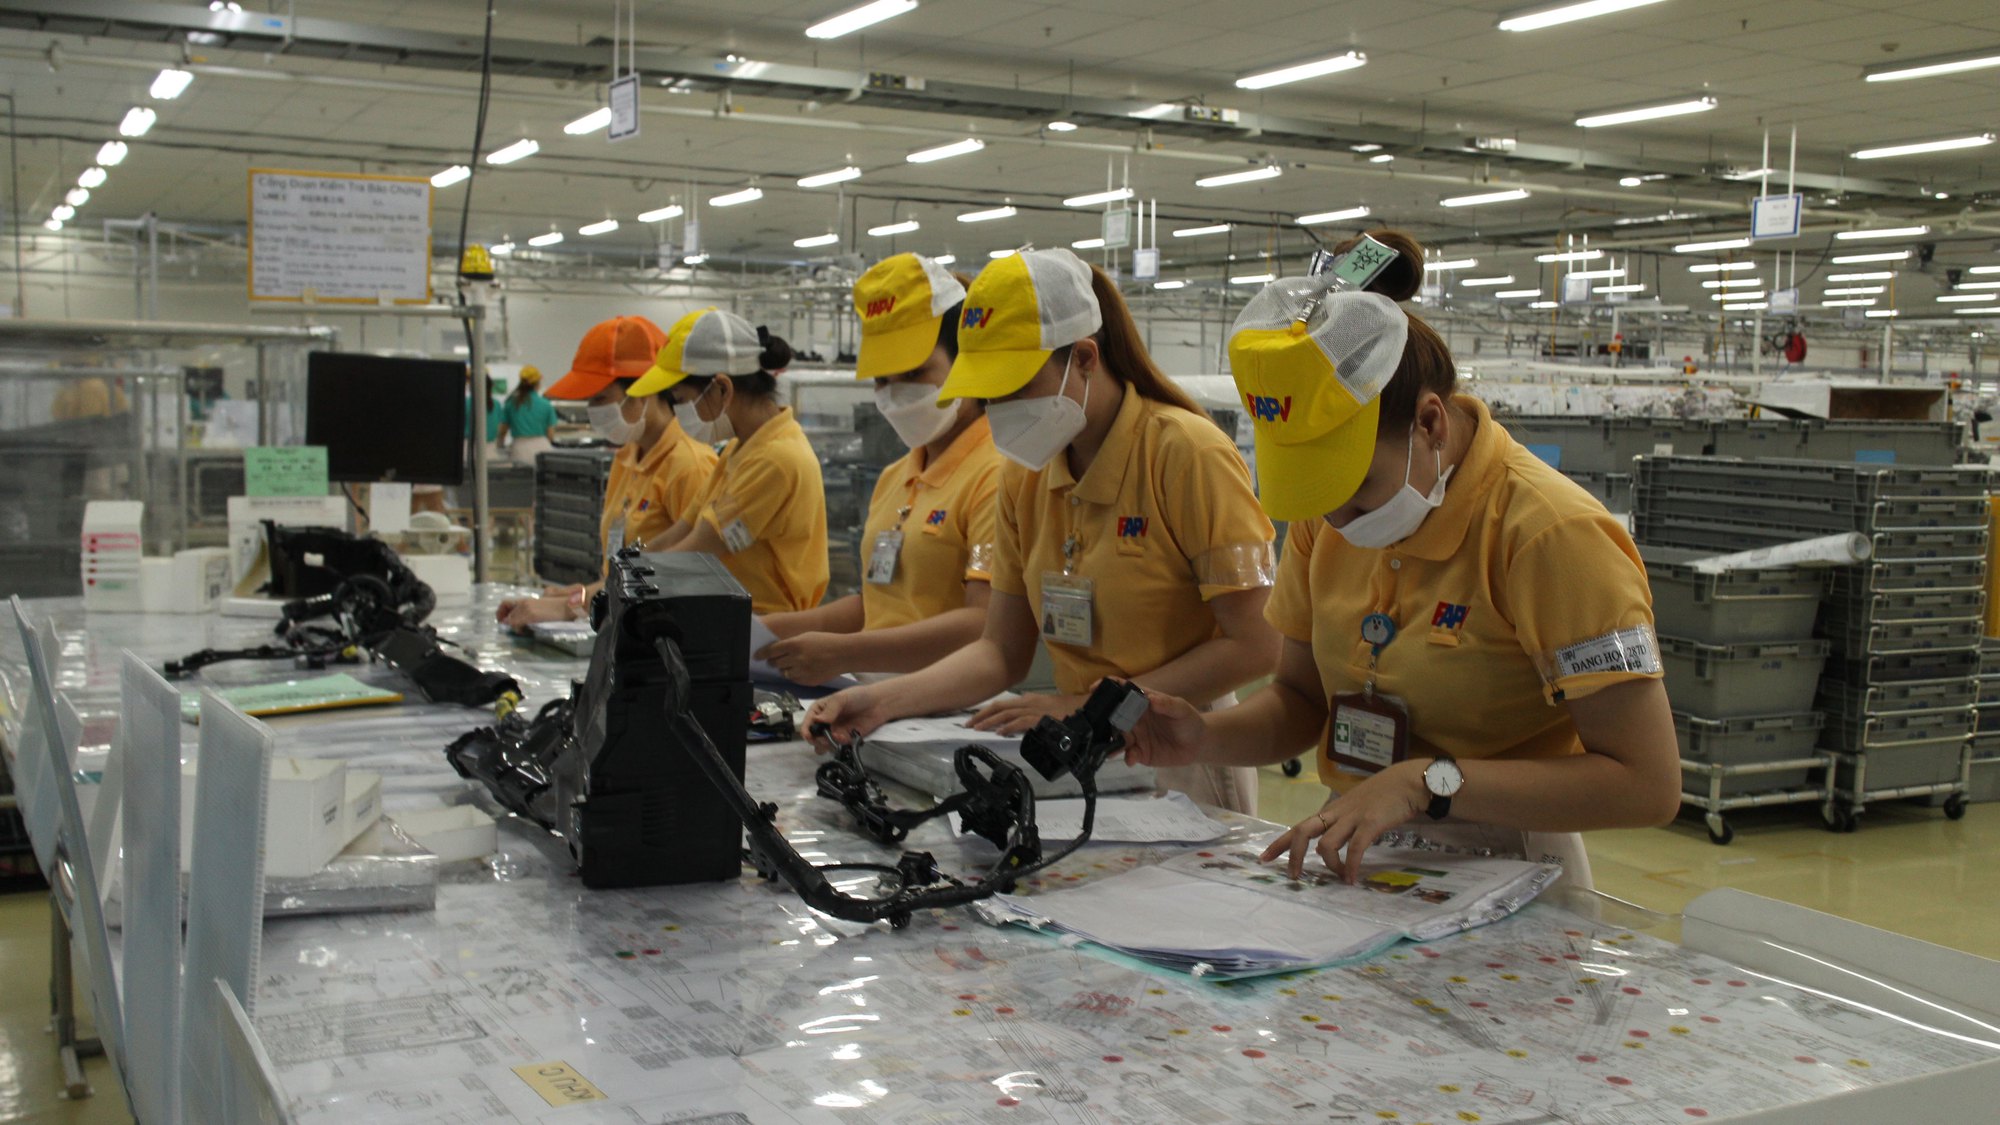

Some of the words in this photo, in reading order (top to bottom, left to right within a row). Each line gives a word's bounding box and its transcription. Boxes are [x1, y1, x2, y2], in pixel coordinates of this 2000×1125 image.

[866, 295, 896, 318] FAPV
[962, 307, 994, 329] FAPV
[1246, 392, 1292, 423] FAPV
[1117, 516, 1149, 538] FAPV
